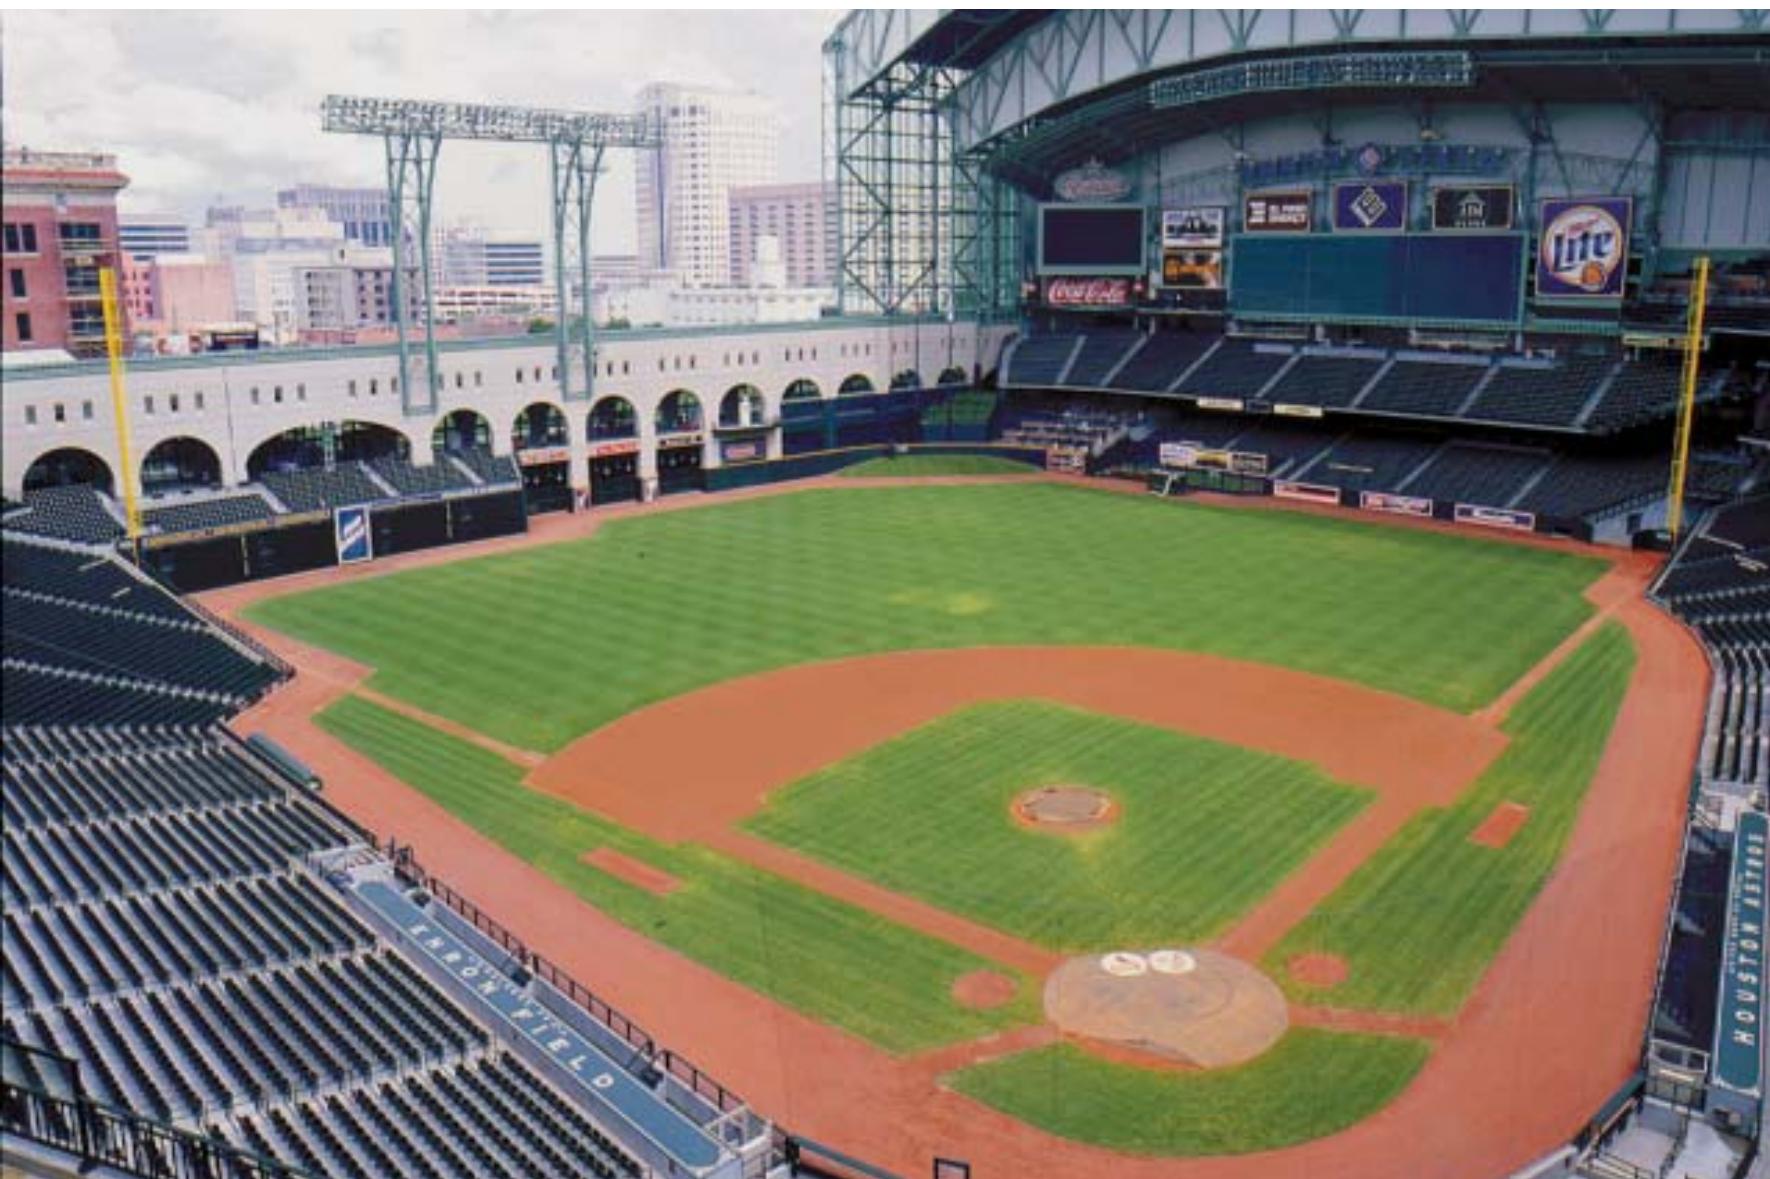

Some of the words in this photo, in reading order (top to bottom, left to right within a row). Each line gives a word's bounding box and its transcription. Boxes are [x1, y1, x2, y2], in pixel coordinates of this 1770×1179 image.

[1551, 231, 1614, 272] Lite
[1742, 833, 1764, 908] ASTROS
[409, 924, 498, 995] ENRON
[510, 1008, 615, 1088] FIELD
[1731, 922, 1760, 1046] HOUSTON
